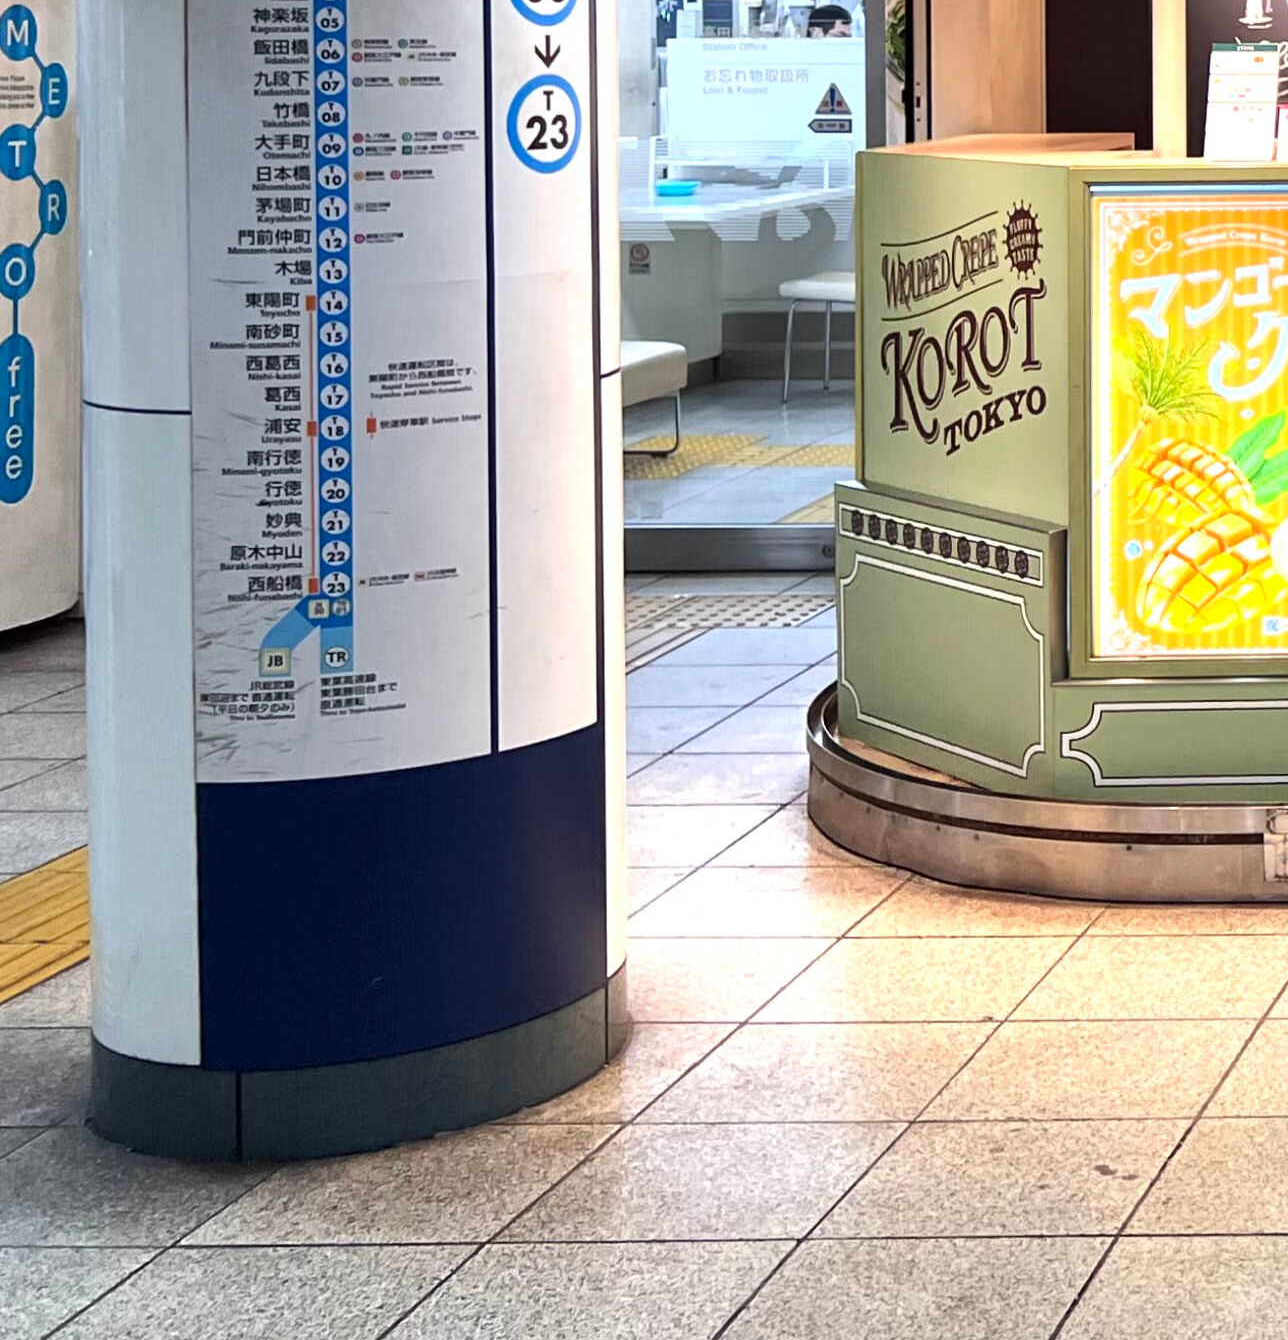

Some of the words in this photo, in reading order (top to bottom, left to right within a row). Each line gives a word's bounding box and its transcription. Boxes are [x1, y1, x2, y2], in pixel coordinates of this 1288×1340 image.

[252, 7, 309, 24] 神楽坂
[321, 18, 339, 29] 05
[253, 39, 309, 56] 飯田橋
[321, 49, 340, 60] 06
[254, 71, 310, 88] 九段下
[703, 68, 810, 83] お忘れ物取扱所
[322, 81, 341, 92] 07
[543, 91, 554, 110] T
[273, 102, 310, 119] 竹橋
[322, 112, 341, 123] 08
[526, 115, 569, 151] 23
[255, 133, 310, 150] 大手町
[322, 143, 342, 154] 09
[256, 165, 311, 182] 日本橋
[324, 175, 342, 186] 10
[255, 197, 311, 214] 茅場町
[324, 207, 341, 217] 11
[238, 228, 312, 246] 門前仲町
[325, 238, 342, 249] 12
[275, 260, 312, 276] 木場
[325, 269, 343, 280] 13
[245, 292, 300, 309] 東陽町
[325, 301, 343, 311] 14
[245, 323, 300, 340] 南砂町
[326, 332, 343, 343] 15
[326, 364, 344, 374] 16
[881, 278, 1047, 444] KOROT
[5, 357, 23, 479] free
[264, 418, 301, 434] 浦安
[944, 386, 1046, 456] TOKYO
[247, 450, 302, 466] 南行徳
[265, 481, 302, 497] 行徳
[266, 513, 302, 529] 妙典
[230, 545, 303, 561] 原木中山
[248, 576, 303, 592] 西船橋
[267, 655, 284, 667] JB
[327, 651, 346, 663] TR
